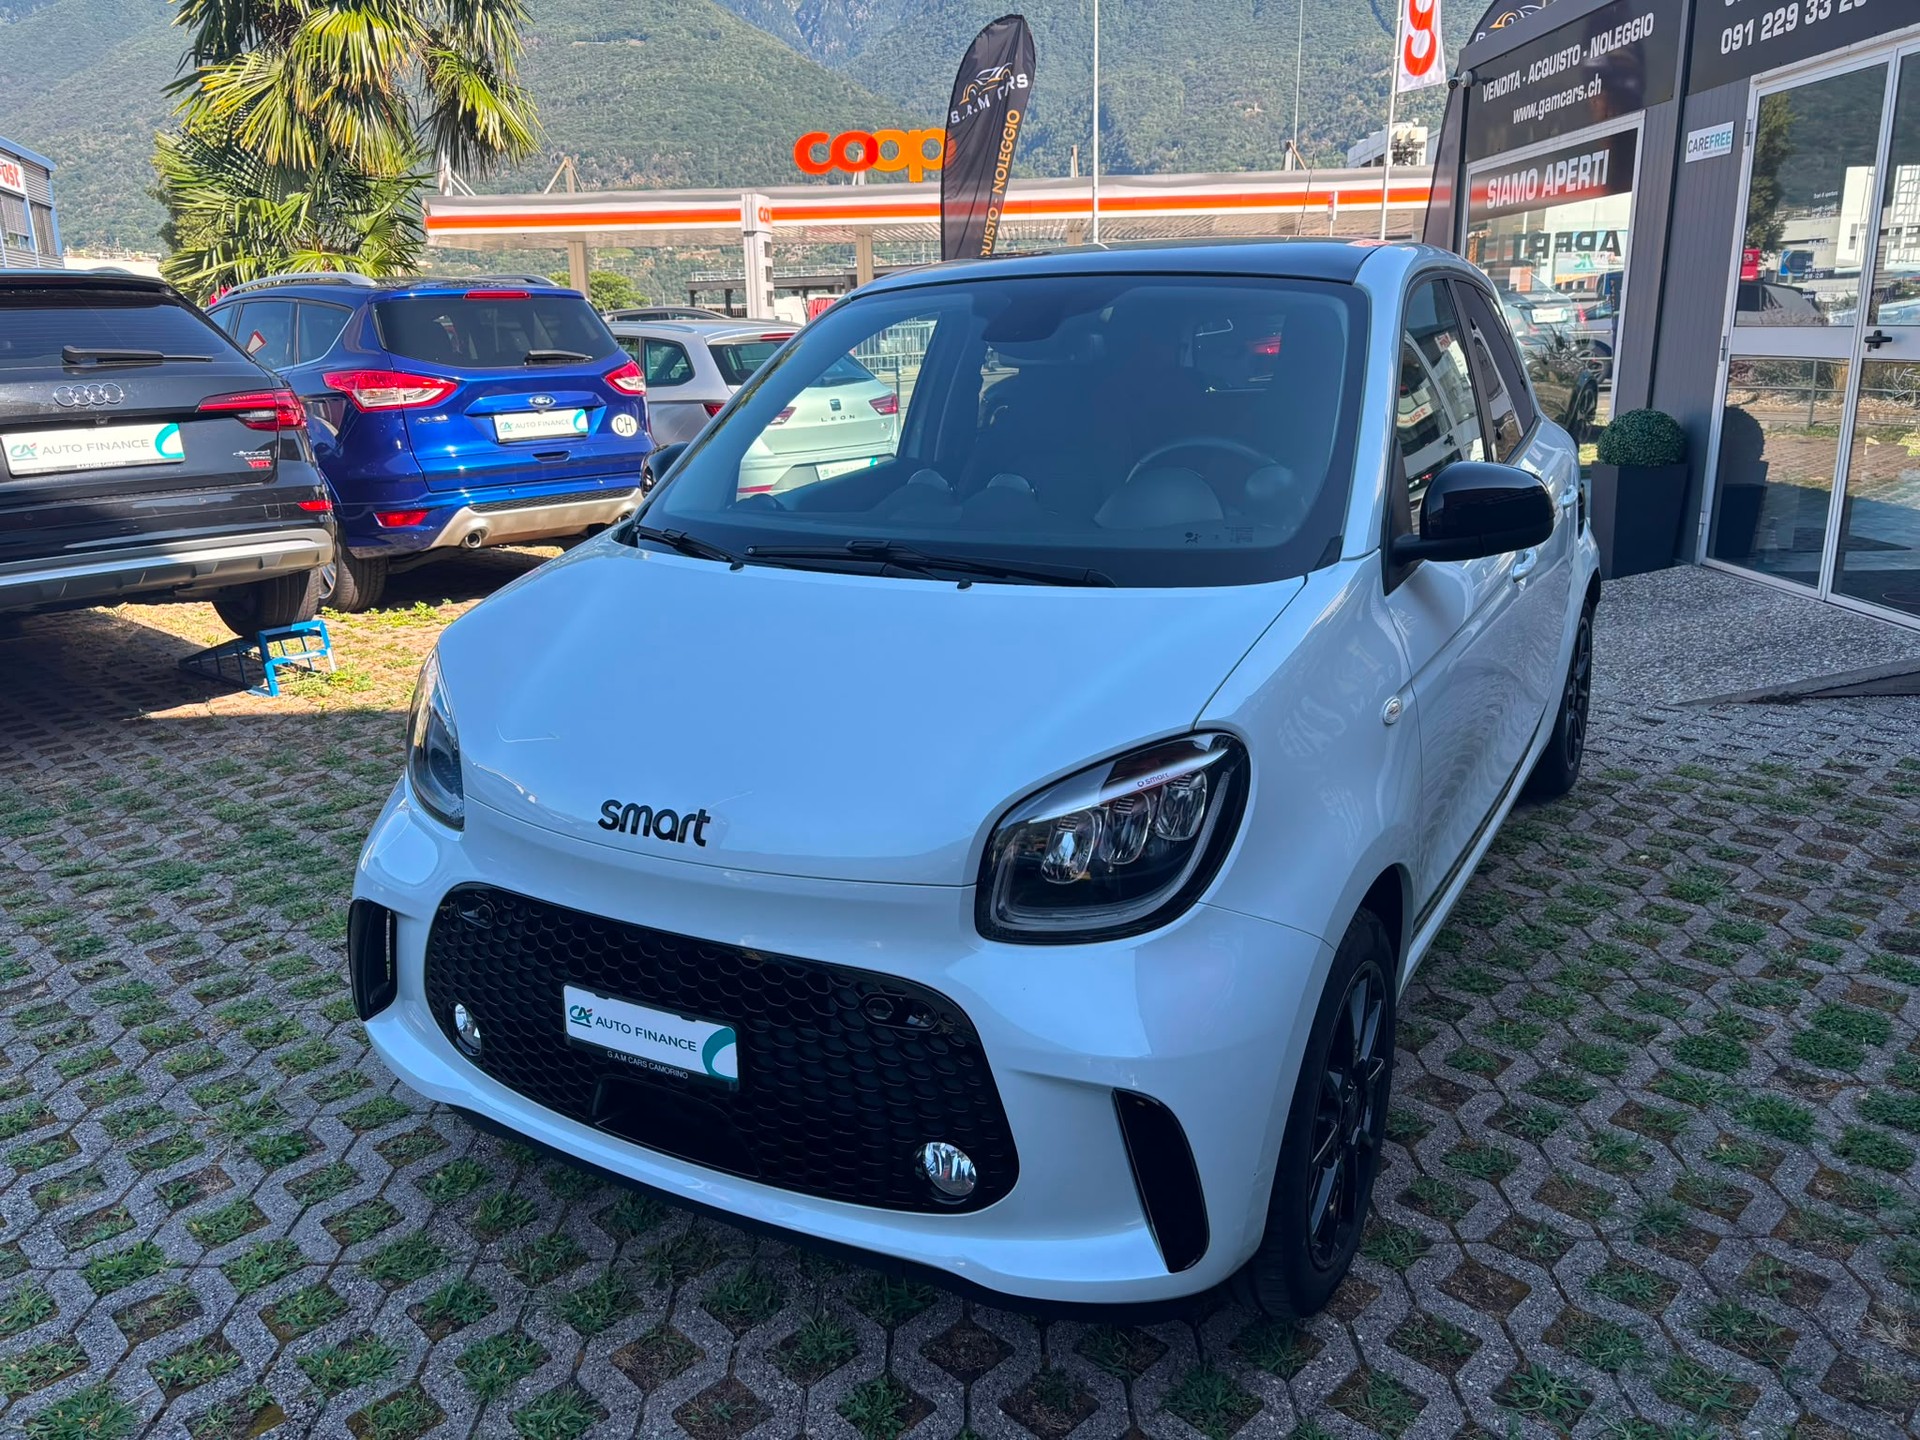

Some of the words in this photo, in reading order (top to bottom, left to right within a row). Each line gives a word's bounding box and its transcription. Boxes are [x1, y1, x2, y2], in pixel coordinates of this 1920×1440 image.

[1720, 18, 1755, 55] 091
[1760, 2, 1799, 41] 229
[1804, 0, 1832, 25] 33
[1482, 70, 1521, 103] VENDITA
[1527, 44, 1581, 85] ACQUISTO
[1590, 12, 1655, 58] NOLEGGIO
[1513, 73, 1602, 124] www.gamcars.ch
[793, 128, 956, 182] coop
[992, 109, 1021, 195] NOLEGGIO
[1687, 130, 1731, 154] CAREFREE
[1486, 168, 1539, 210] SIAMO
[1541, 149, 1610, 198] APERTI
[515, 421, 536, 429] AUTO
[537, 418, 571, 427] FINANCE
[615, 418, 632, 434] CH
[821, 414, 855, 422] LEON
[42, 444, 83, 456] AUTO
[86, 439, 150, 452] FINANCE
[1145, 772, 1169, 785] smart
[597, 799, 711, 847] smart
[595, 1015, 632, 1035] AUTO
[635, 1027, 697, 1052] FINANCE
[628, 1056, 648, 1069] CARS
[648, 1062, 689, 1080] CAMORINO
